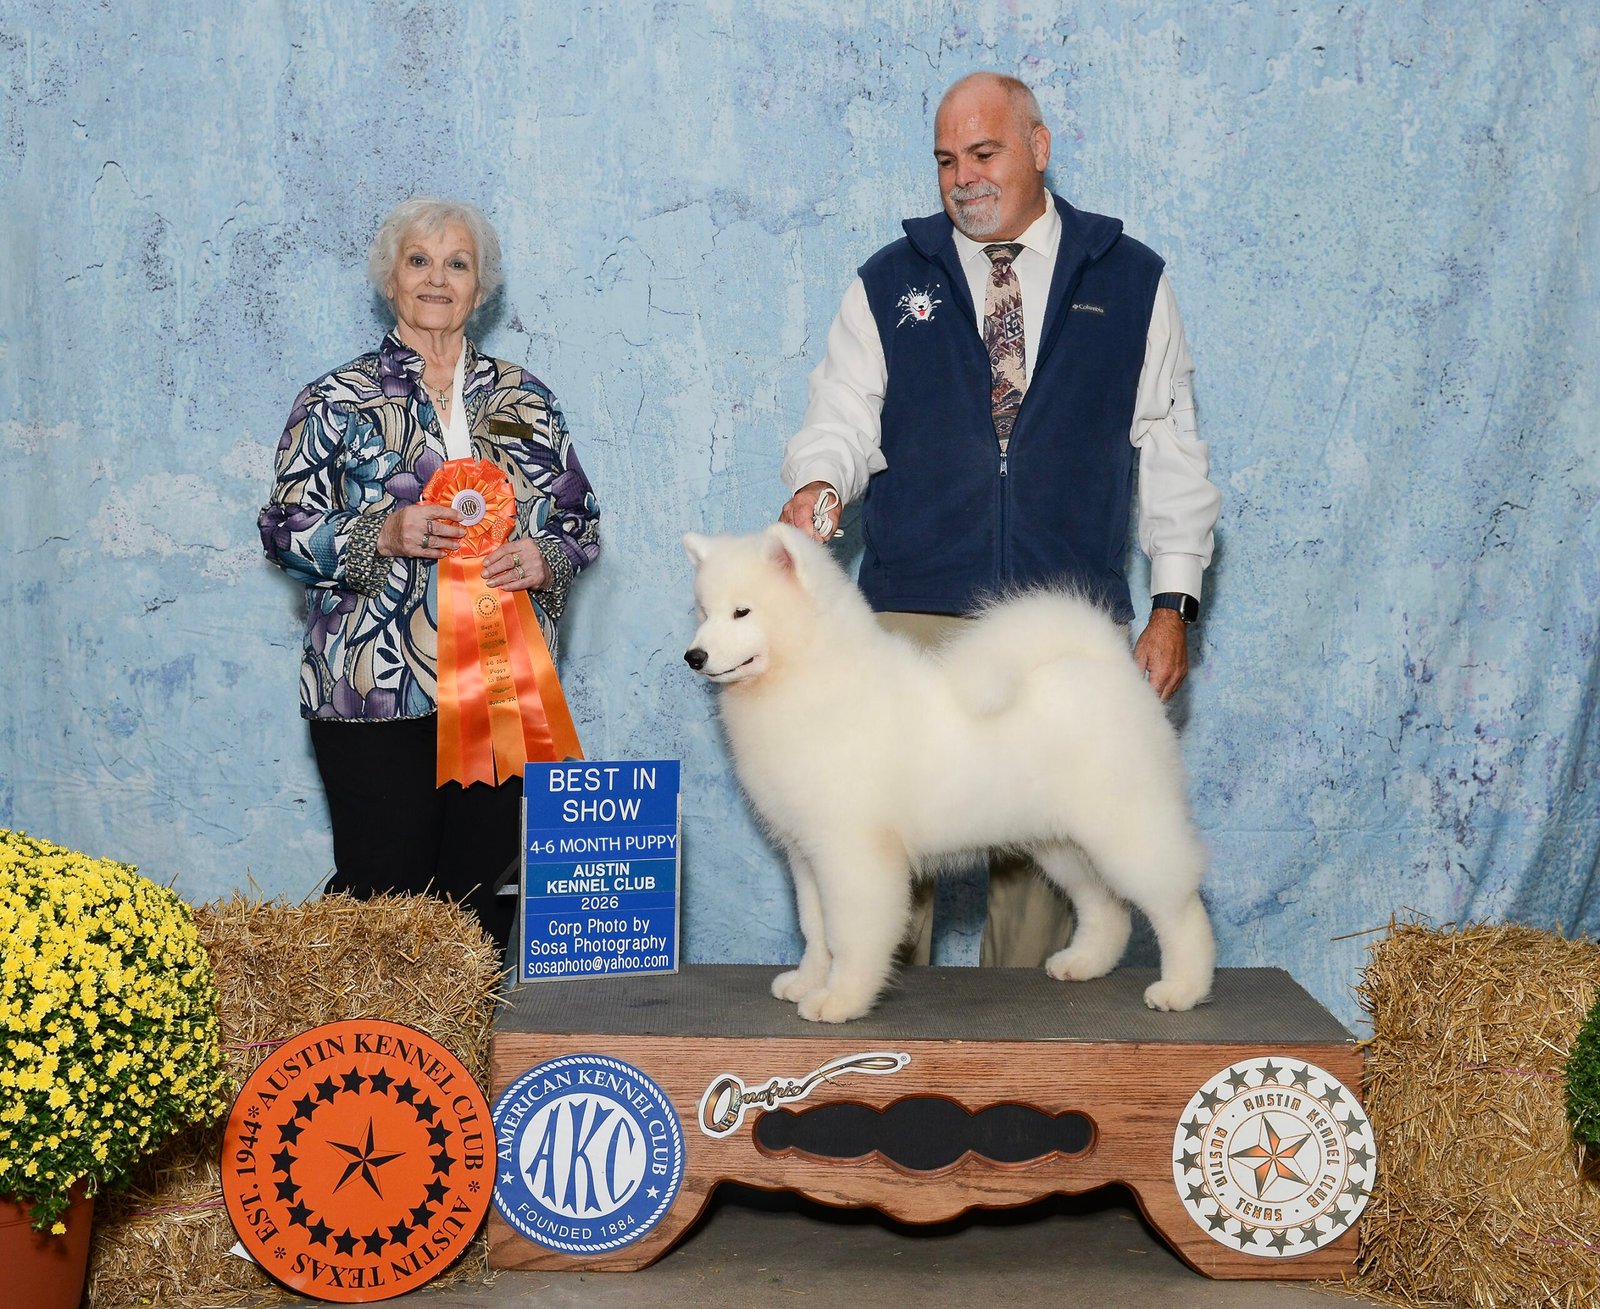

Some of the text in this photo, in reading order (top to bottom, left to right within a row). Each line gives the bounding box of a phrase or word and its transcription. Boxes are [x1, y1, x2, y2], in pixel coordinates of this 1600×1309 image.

[550, 767, 656, 792] BEST IN
[562, 798, 641, 822] SHOW
[530, 834, 677, 854] 4-6 MONTH PUPPY
[573, 863, 630, 877] AUSTIN
[546, 876, 656, 894] KENNEL CLUB
[581, 896, 619, 910] 2026
[548, 916, 650, 937] Corp Photo by
[530, 934, 667, 956] Sosa Photography
[528, 954, 669, 975] sosaphoto@yahoo.com
[257, 1033, 484, 1171] AUSTIN KENNEL CLUB
[497, 1069, 669, 1176] AMERICAN KENNEL CLUB
[525, 1098, 636, 1215] AKC
[1243, 1093, 1340, 1209] AUSTIN KENNEL CLUB
[236, 1119, 281, 1245] EST. 1944
[517, 1202, 635, 1240] FOUNDED 1884
[1235, 1197, 1283, 1222] TEXAS
[291, 1195, 472, 1289] AUSTIN TEXAS
